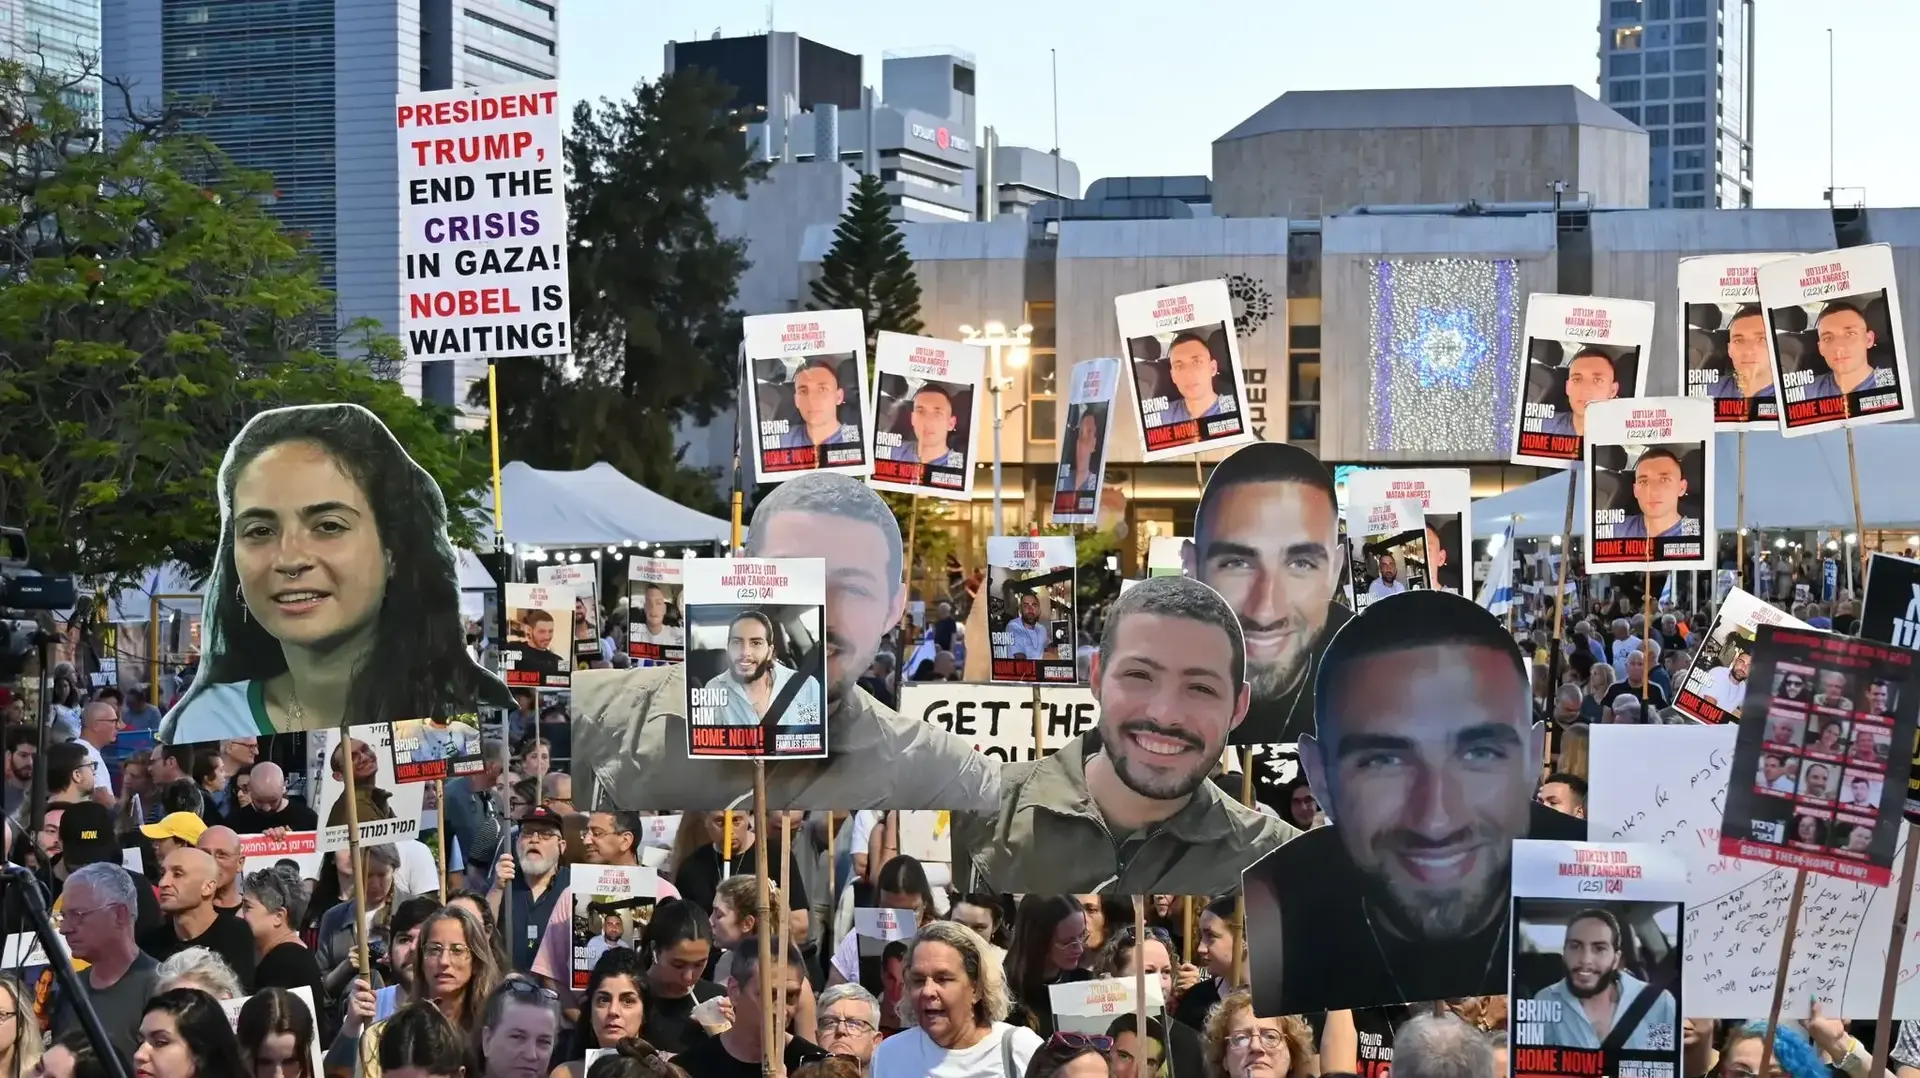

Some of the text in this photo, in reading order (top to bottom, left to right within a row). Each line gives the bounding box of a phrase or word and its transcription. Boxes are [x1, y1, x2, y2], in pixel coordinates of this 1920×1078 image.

[398, 92, 557, 127] PRESIDENT
[411, 131, 545, 166] TRUMP,
[409, 169, 553, 205] END THE
[424, 210, 540, 244] CRISIS
[407, 245, 561, 279] IN GAZA!
[410, 284, 563, 318] NOBEL IS
[409, 322, 565, 355] WAITING!
[1689, 369, 1719, 384] BRING
[1783, 370, 1815, 388] BRING
[1688, 385, 1707, 397] HIM
[1785, 387, 1805, 403] HIM
[1141, 396, 1169, 414] BRING
[1525, 402, 1555, 419] BRING
[1788, 402, 1818, 419] HOME
[761, 419, 789, 435] BRING
[1144, 412, 1162, 428] HIM
[1523, 418, 1543, 433] HIM
[762, 435, 781, 450] HIM
[876, 431, 902, 447] BRING
[1147, 426, 1172, 444] HOME
[1521, 434, 1580, 453] HOME NOW!
[875, 445, 892, 460] HIM
[1595, 509, 1625, 524] BRING
[1595, 524, 1614, 539] HIM
[1595, 540, 1623, 555] HOME
[721, 576, 788, 586] MATAN ZANGAUKER
[992, 632, 1015, 645] BRING
[993, 645, 1008, 659] HIM
[1690, 666, 1715, 688] BRING
[1684, 679, 1702, 695] HIM
[691, 688, 728, 707] BRING
[1679, 692, 1724, 723] HOME NOW!
[692, 707, 715, 726] HIM
[923, 700, 1095, 738] GET THE
[693, 726, 764, 746] HOME NOW!
[394, 737, 419, 752] BRING
[395, 750, 412, 765] HIM
[396, 762, 421, 778] HOME
[421, 760, 446, 775] NOW!
[1690, 749, 1735, 788] ולכים
[359, 823, 388, 839] נמרוד
[390, 819, 416, 834] תמיר
[1741, 844, 1772, 859] BRING
[1559, 864, 1642, 879] MATAN ZANGAUKER
[1578, 880, 1603, 893] (25)
[574, 946, 597, 959] BRING
[574, 959, 589, 970] HIM
[1516, 999, 1562, 1022] BRING
[1516, 1022, 1544, 1045] HIM
[1361, 1045, 1377, 1059] HEM
[1515, 1049, 1604, 1074] HOME NOW!
